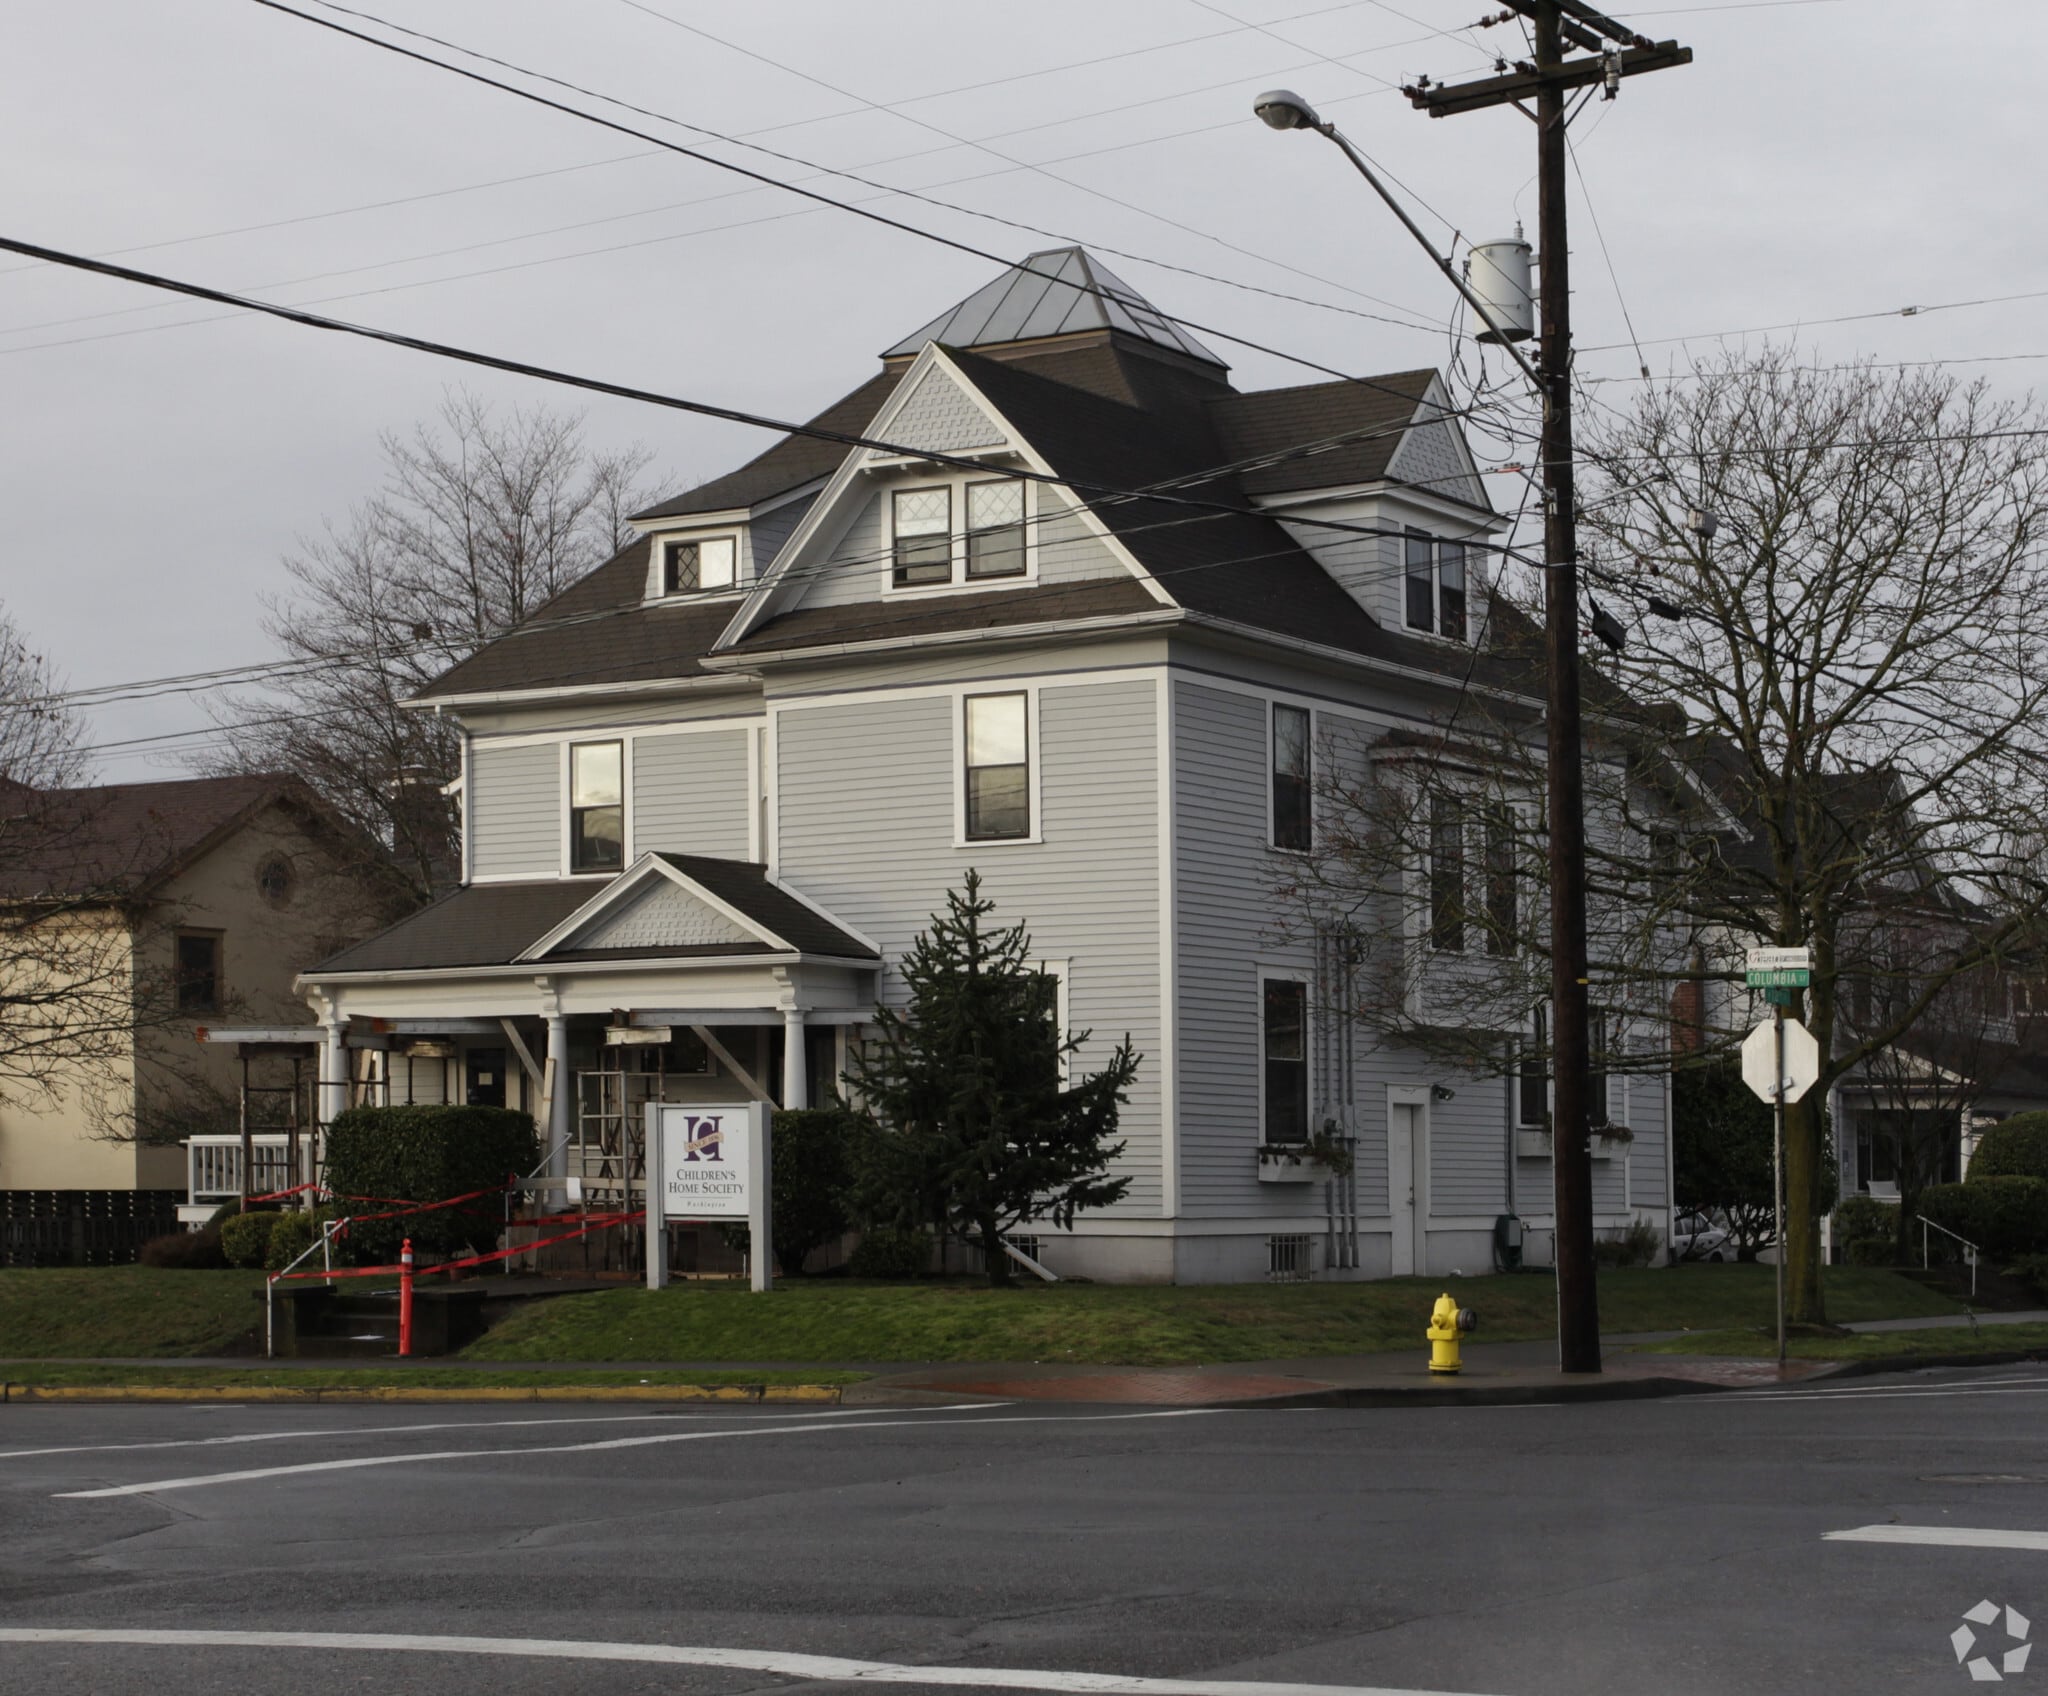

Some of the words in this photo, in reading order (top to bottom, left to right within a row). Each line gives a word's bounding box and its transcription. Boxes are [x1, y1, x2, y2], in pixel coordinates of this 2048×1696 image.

[1749, 973, 1797, 985] COLUMBIA
[677, 1168, 736, 1180] CHILDREN'S
[669, 1182, 699, 1194] HOME
[702, 1182, 744, 1194] SOCIETY
